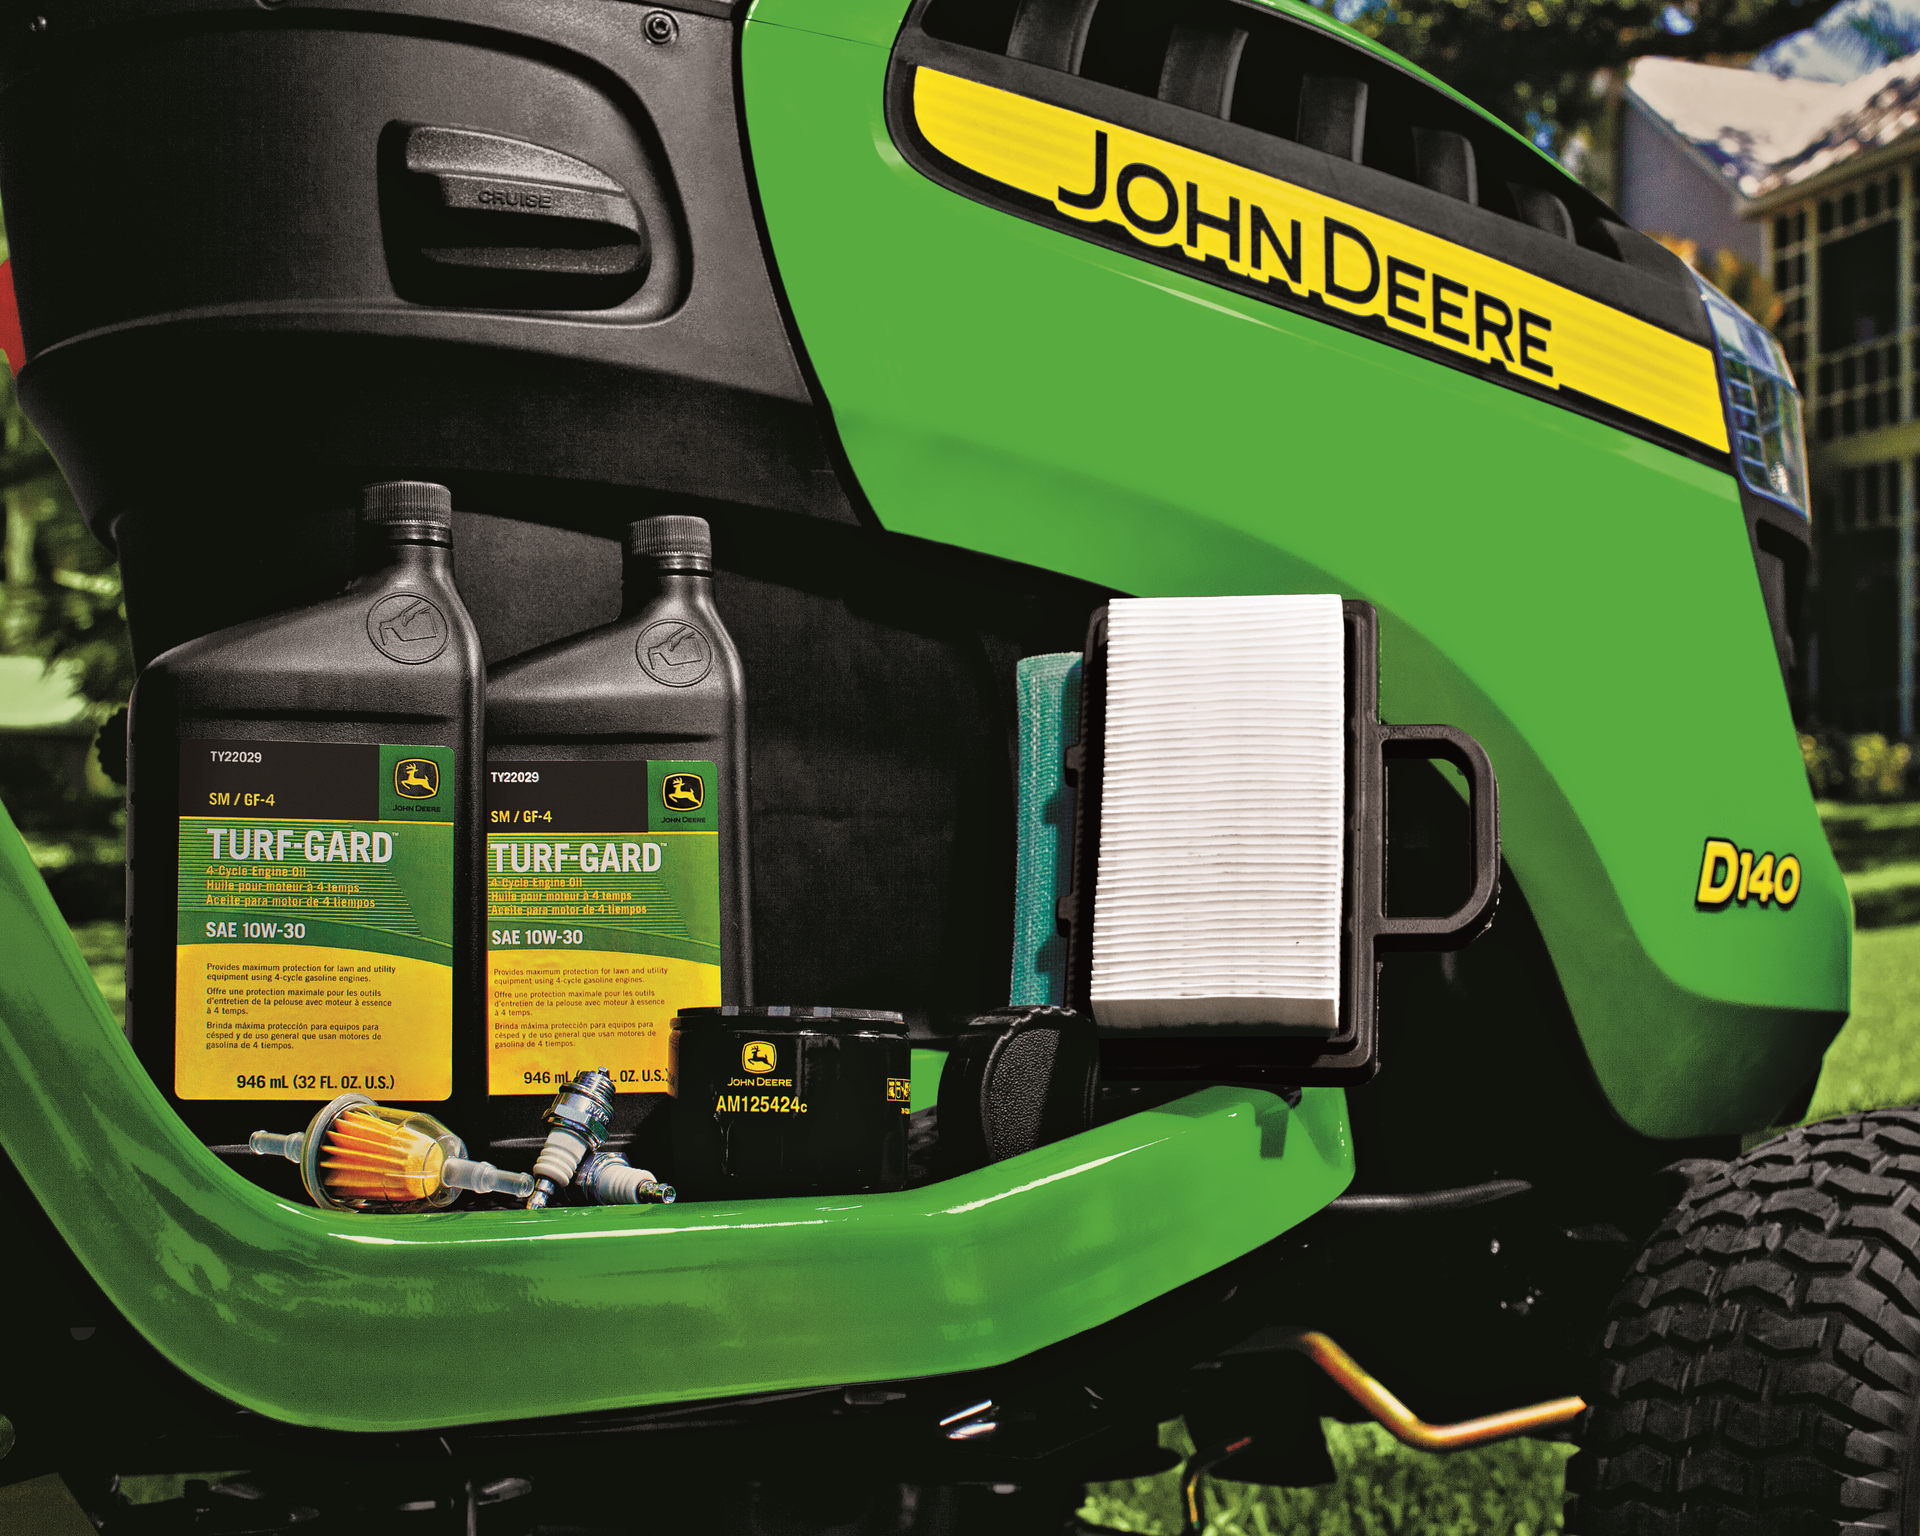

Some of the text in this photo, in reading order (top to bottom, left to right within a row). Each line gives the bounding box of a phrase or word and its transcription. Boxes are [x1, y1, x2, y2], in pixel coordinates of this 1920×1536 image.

[478, 191, 552, 209] CRUISE
[1058, 130, 1554, 378] JOHN DEERE
[210, 751, 262, 763] TY22029
[491, 772, 539, 783] TY22029
[209, 793, 275, 806] SM / GF-4
[392, 804, 414, 812] JOHN
[491, 811, 552, 823] SM / GF-4
[206, 866, 306, 879] 4-Cycle Engine Oil
[1696, 838, 1801, 908] D140
[206, 880, 359, 894] Huile pour moteur à 4 temps
[491, 877, 582, 889] 4-Cycle Engine Oil
[206, 894, 375, 909] Aceite para motor de 4 tiempos
[491, 892, 632, 902] Huile pour moteur temps
[491, 904, 647, 916] Aceite para motor de tiempos
[206, 922, 306, 938] SAE 10W-30
[492, 930, 583, 944] SAE 10W-30
[207, 963, 240, 971] Provides
[242, 964, 279, 972] maximum
[283, 964, 321, 972] protection
[374, 965, 396, 974] utility
[251, 974, 272, 982] using
[275, 974, 302, 982] 4-cycle
[305, 974, 336, 983] gasoline
[339, 975, 370, 983] engines.
[556, 977, 581, 985] 4-cycle
[246, 988, 285, 996] protection
[274, 998, 303, 1006] pelouse
[509, 1009, 532, 1017] temps.
[268, 1023, 308, 1031] protección
[551, 1022, 587, 1030] protección
[608, 1021, 635, 1029] equipos
[554, 1031, 580, 1039] general
[206, 1042, 238, 1050] gasolina
[261, 1042, 294, 1050] tiempos.
[495, 1040, 575, 1049] gasolina tiempos.
[237, 1075, 266, 1088] 946
[270, 1076, 288, 1089] mL
[293, 1074, 315, 1089] (32
[320, 1076, 337, 1089] FL.
[365, 1075, 395, 1089] U.S.)
[524, 1071, 550, 1084] 946
[554, 1071, 571, 1083] mL
[727, 1077, 792, 1087] JOHN DEERE
